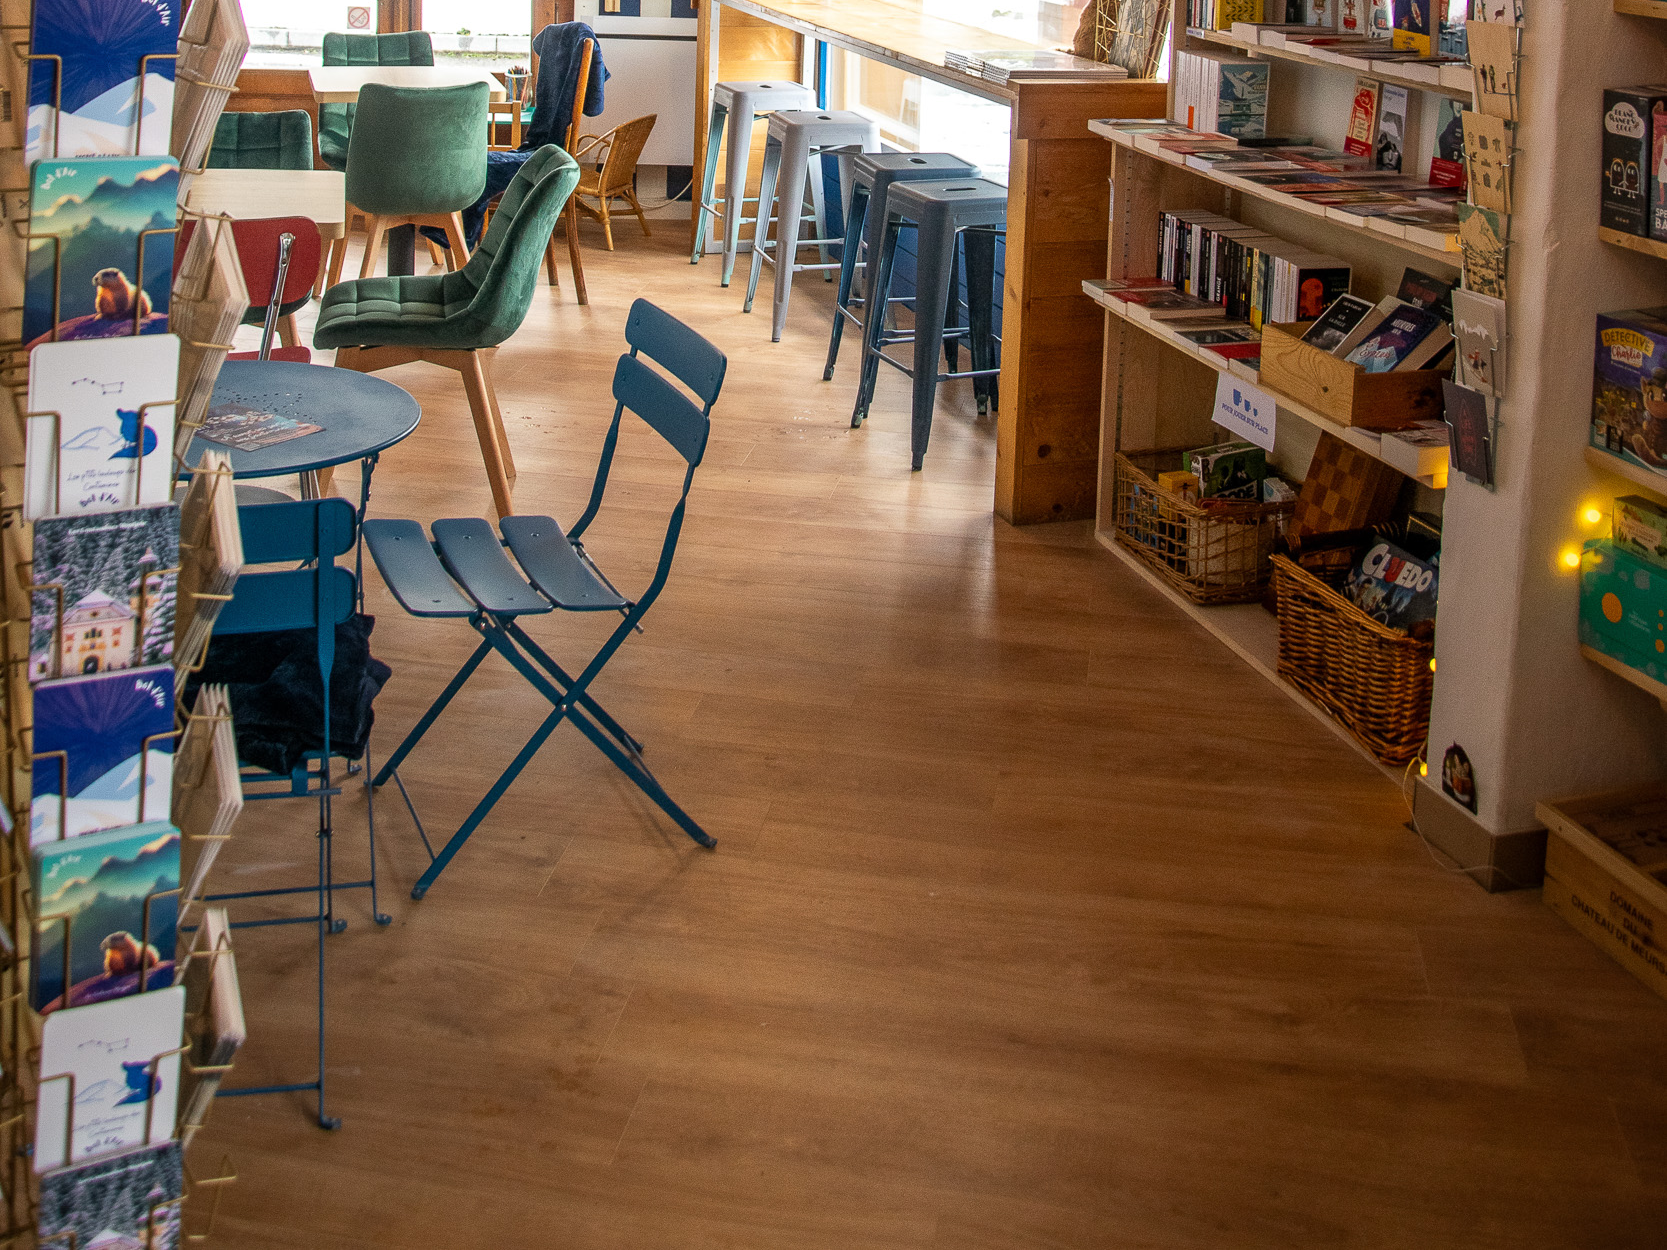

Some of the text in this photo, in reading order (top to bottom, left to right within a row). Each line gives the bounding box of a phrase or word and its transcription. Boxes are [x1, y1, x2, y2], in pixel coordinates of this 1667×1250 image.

[156, 2, 171, 27] d'Air
[1656, 207, 1667, 217] SPE
[1655, 217, 1667, 231] BA
[1604, 330, 1649, 352] DÉTECTIVE
[1612, 345, 1641, 359] Charlie
[1222, 403, 1268, 434] POUR JOUER SUR PLACE
[1362, 543, 1433, 592] CLUEDO
[1610, 891, 1653, 931] DOMAINE
[1571, 894, 1667, 976] CHATEAU DE MEURS
[1623, 916, 1637, 935] DU
